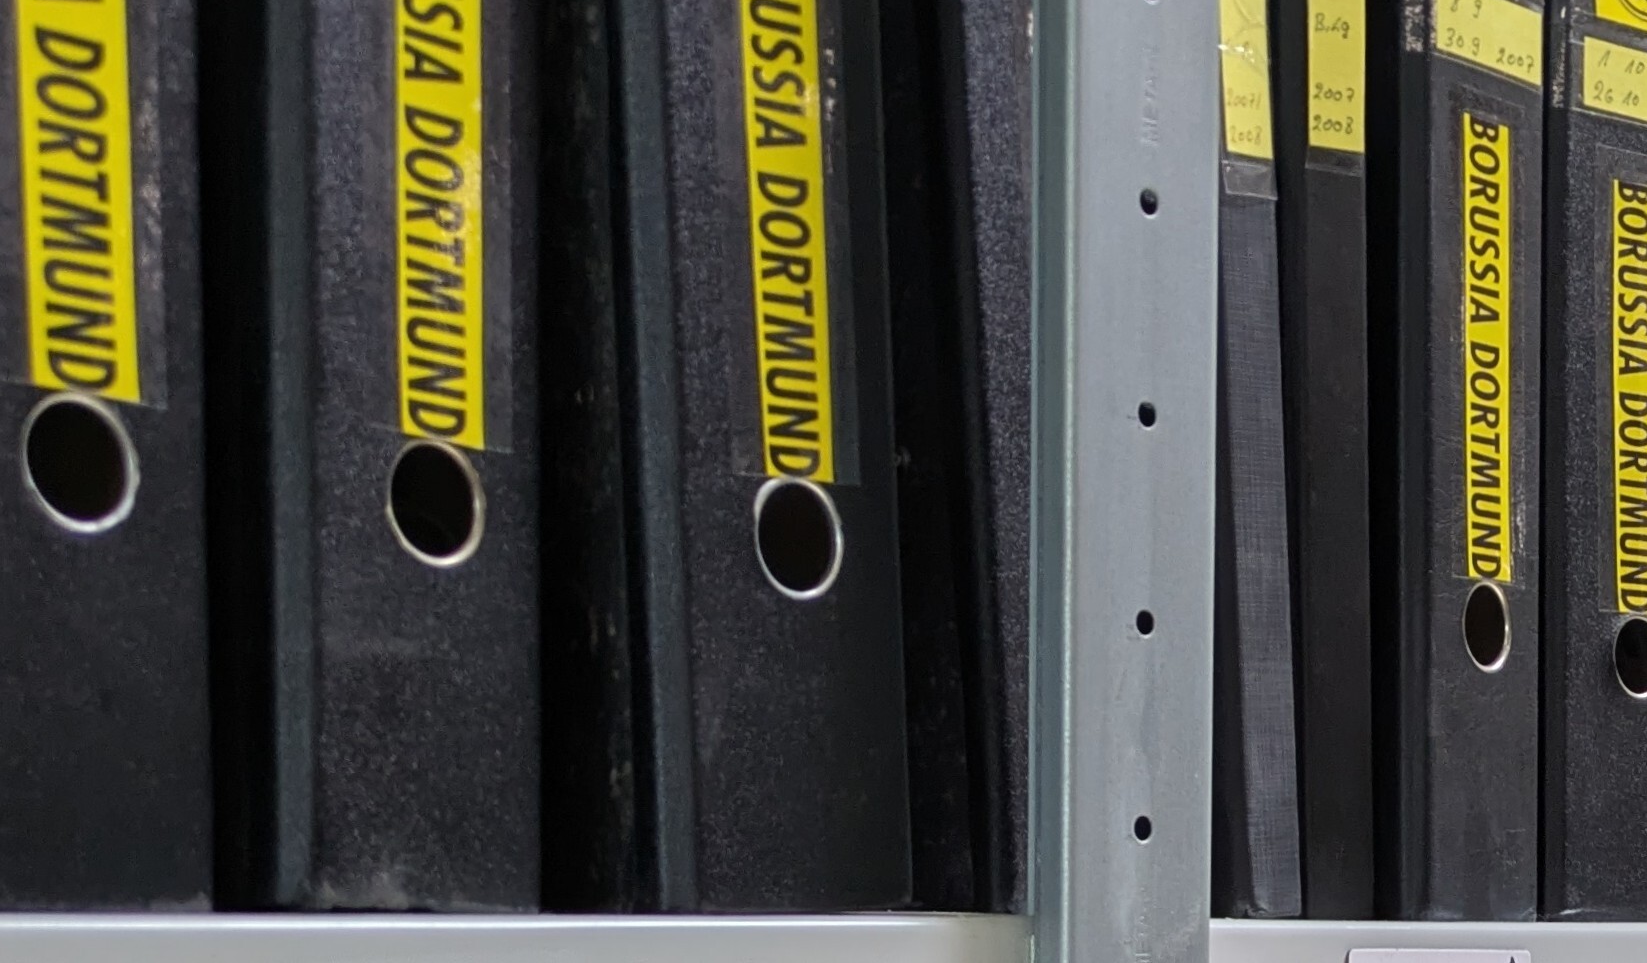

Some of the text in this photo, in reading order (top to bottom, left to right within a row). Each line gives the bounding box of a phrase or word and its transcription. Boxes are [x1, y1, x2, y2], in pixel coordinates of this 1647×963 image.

[1496, 45, 1536, 74] 2007
[1624, 57, 1646, 76] 10
[1313, 82, 1355, 103] 2007
[1593, 81, 1615, 104] 26
[1621, 89, 1640, 107] 10
[1312, 114, 1354, 135] 2008
[34, 26, 118, 393] DORTMUND
[404, 108, 468, 441] DORTMUND
[756, 171, 821, 482] DORTMUND
[1469, 115, 1502, 580] BORUSSIA DORTMUND
